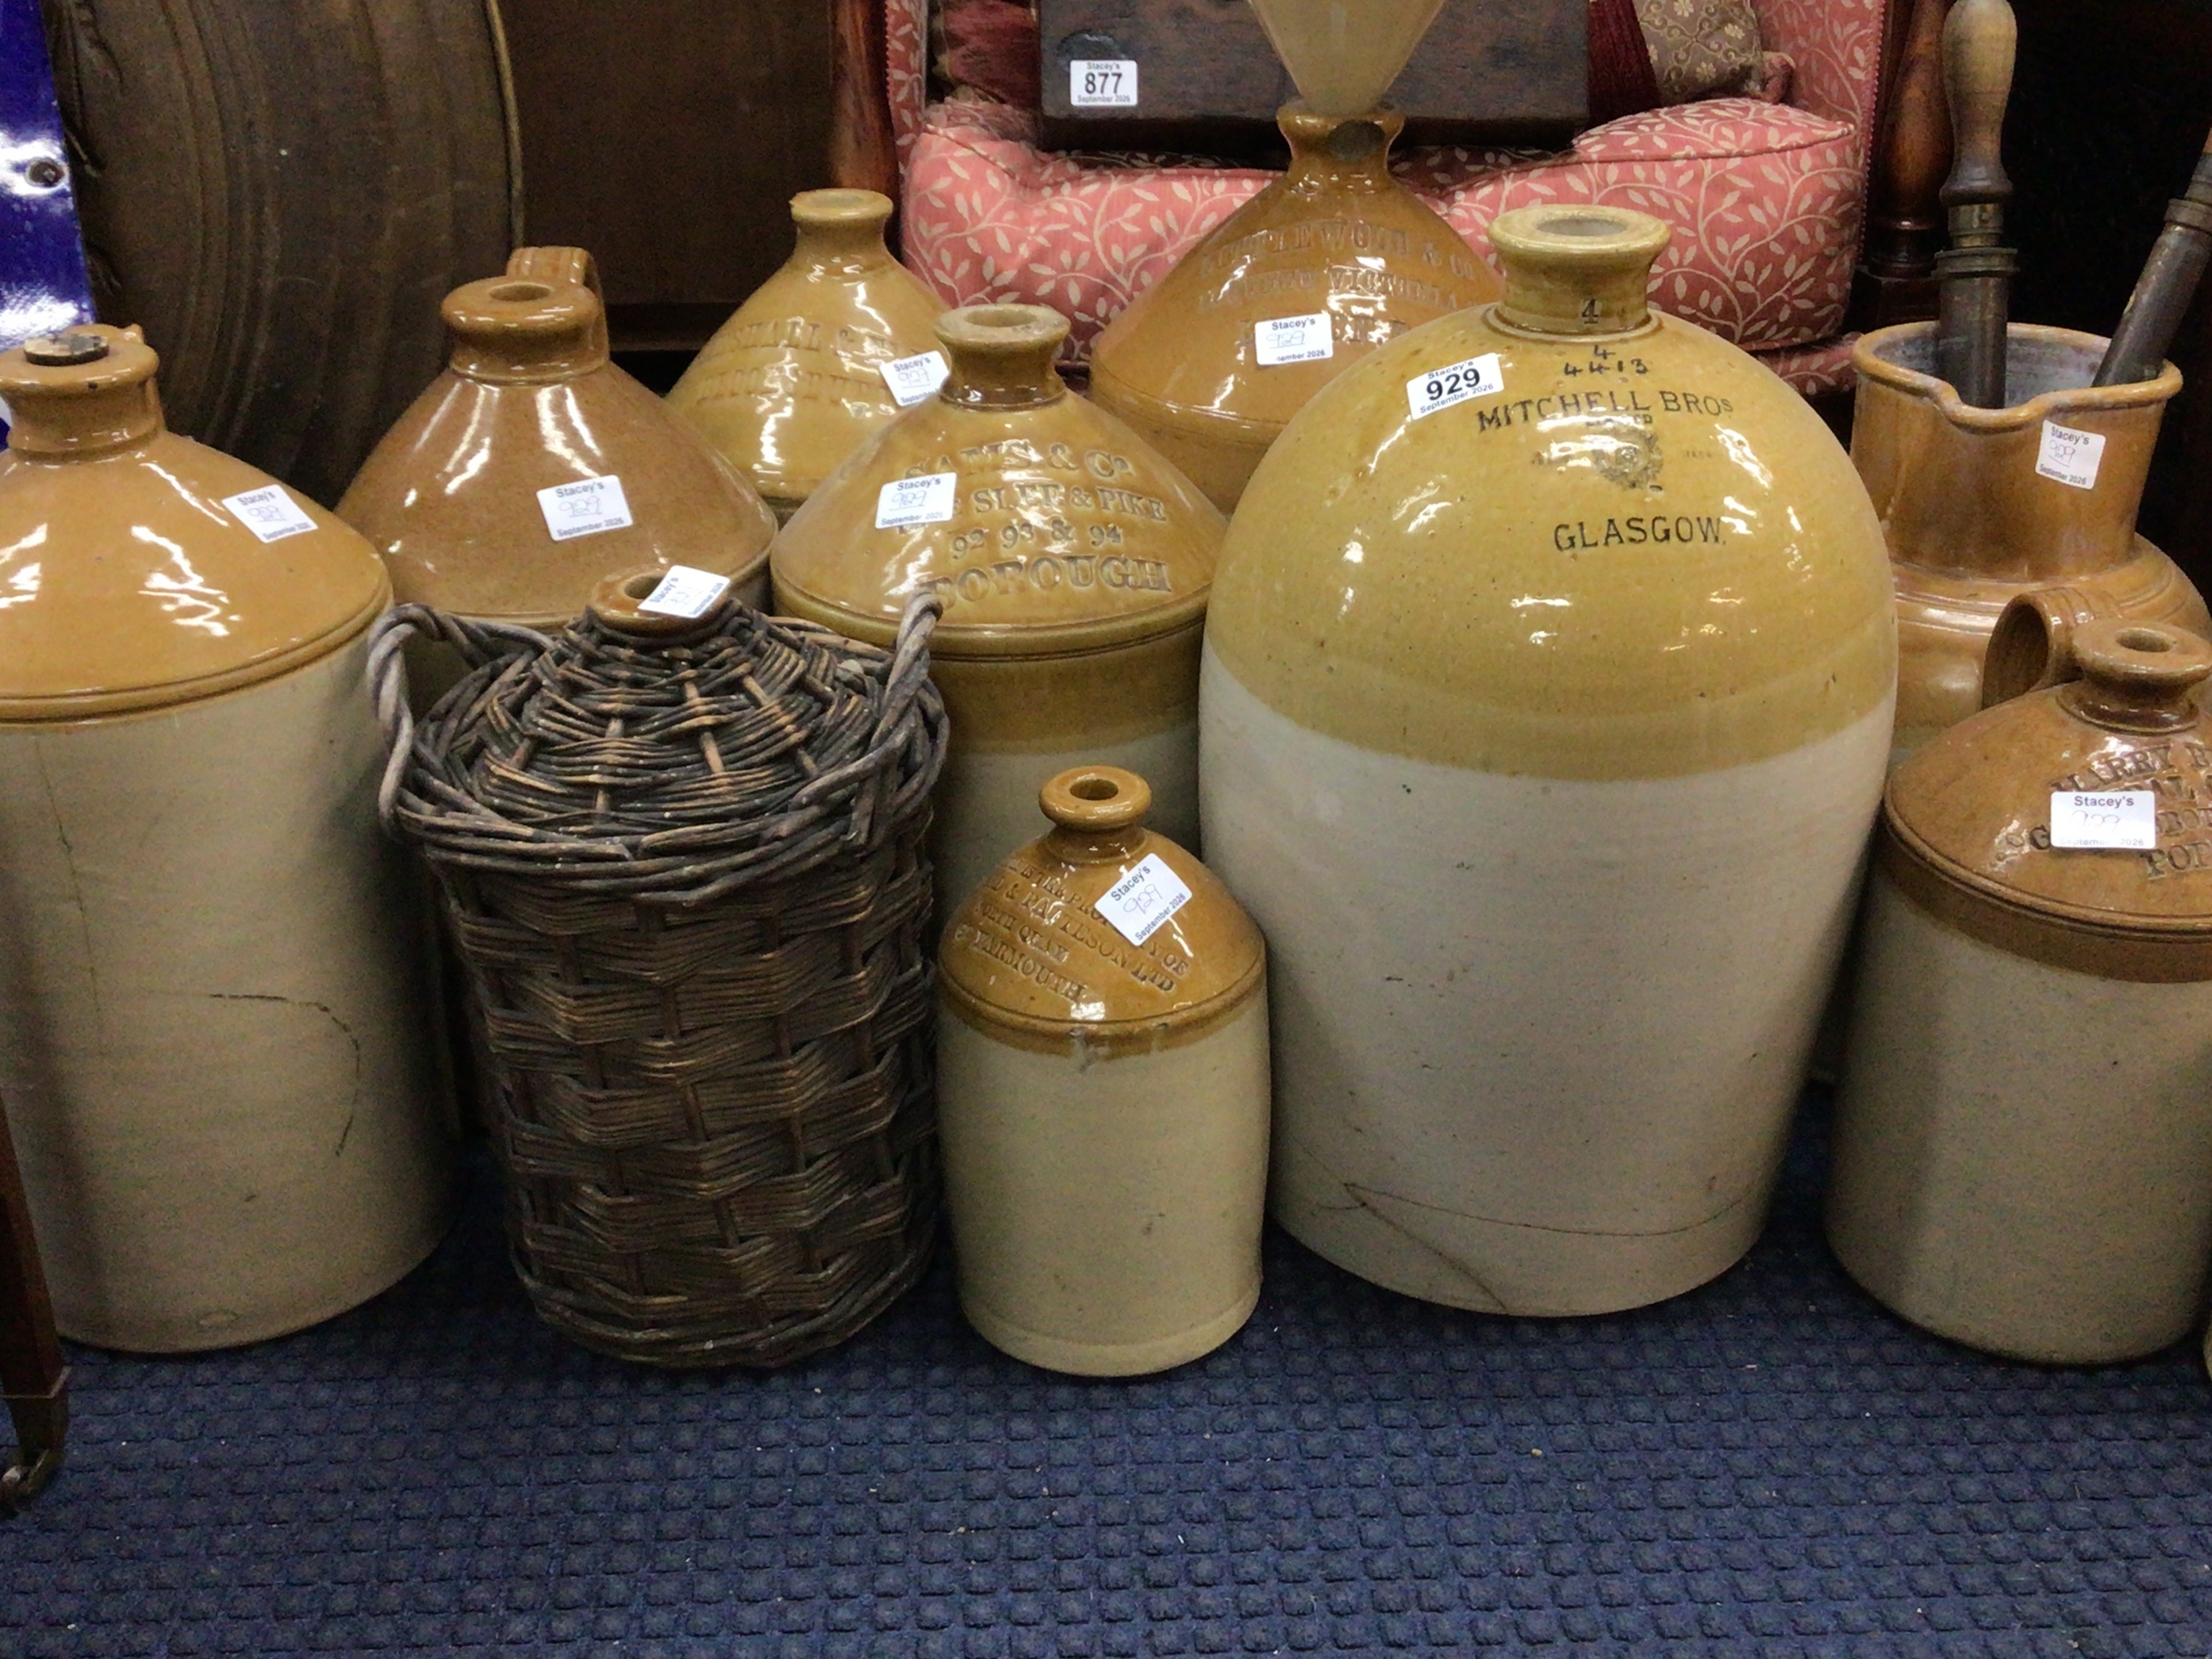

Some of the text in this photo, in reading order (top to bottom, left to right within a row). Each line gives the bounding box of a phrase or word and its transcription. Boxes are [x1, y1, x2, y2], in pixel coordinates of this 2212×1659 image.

[1087, 62, 1120, 71] Stacey's
[1085, 72, 1123, 95] 877
[1077, 95, 1113, 104] September
[1581, 298, 1600, 325] 4
[1271, 317, 1316, 331] Stacey's
[893, 356, 932, 373] Stacey's
[1307, 349, 1326, 358] 2026
[1427, 360, 1474, 380] Stacey's
[1425, 367, 1481, 402] 929
[1419, 383, 1494, 414] September 2026
[1476, 389, 1651, 434] MITCHELL
[2050, 425, 2091, 446] Stacey's
[1046, 442, 1080, 472] &
[896, 477, 941, 492] Stacey's
[2039, 463, 2087, 486] September 2026
[555, 481, 605, 498] Stacey's
[1070, 486, 1094, 509] &
[1095, 486, 1168, 523] PIKE
[557, 517, 625, 537] September 2026
[881, 514, 923, 526] September
[1001, 520, 1034, 549] 93
[1050, 518, 1077, 541] &
[1088, 525, 1123, 547] 94
[2074, 795, 2134, 810] Stacey's
[1110, 864, 1151, 902] Stacey's
[1122, 883, 1164, 916] 929
[1134, 892, 1187, 941] September 2026
[973, 928, 1087, 1002] YARMOUTH
[1162, 952, 1189, 973] OF
[1130, 960, 1175, 992] LTD
